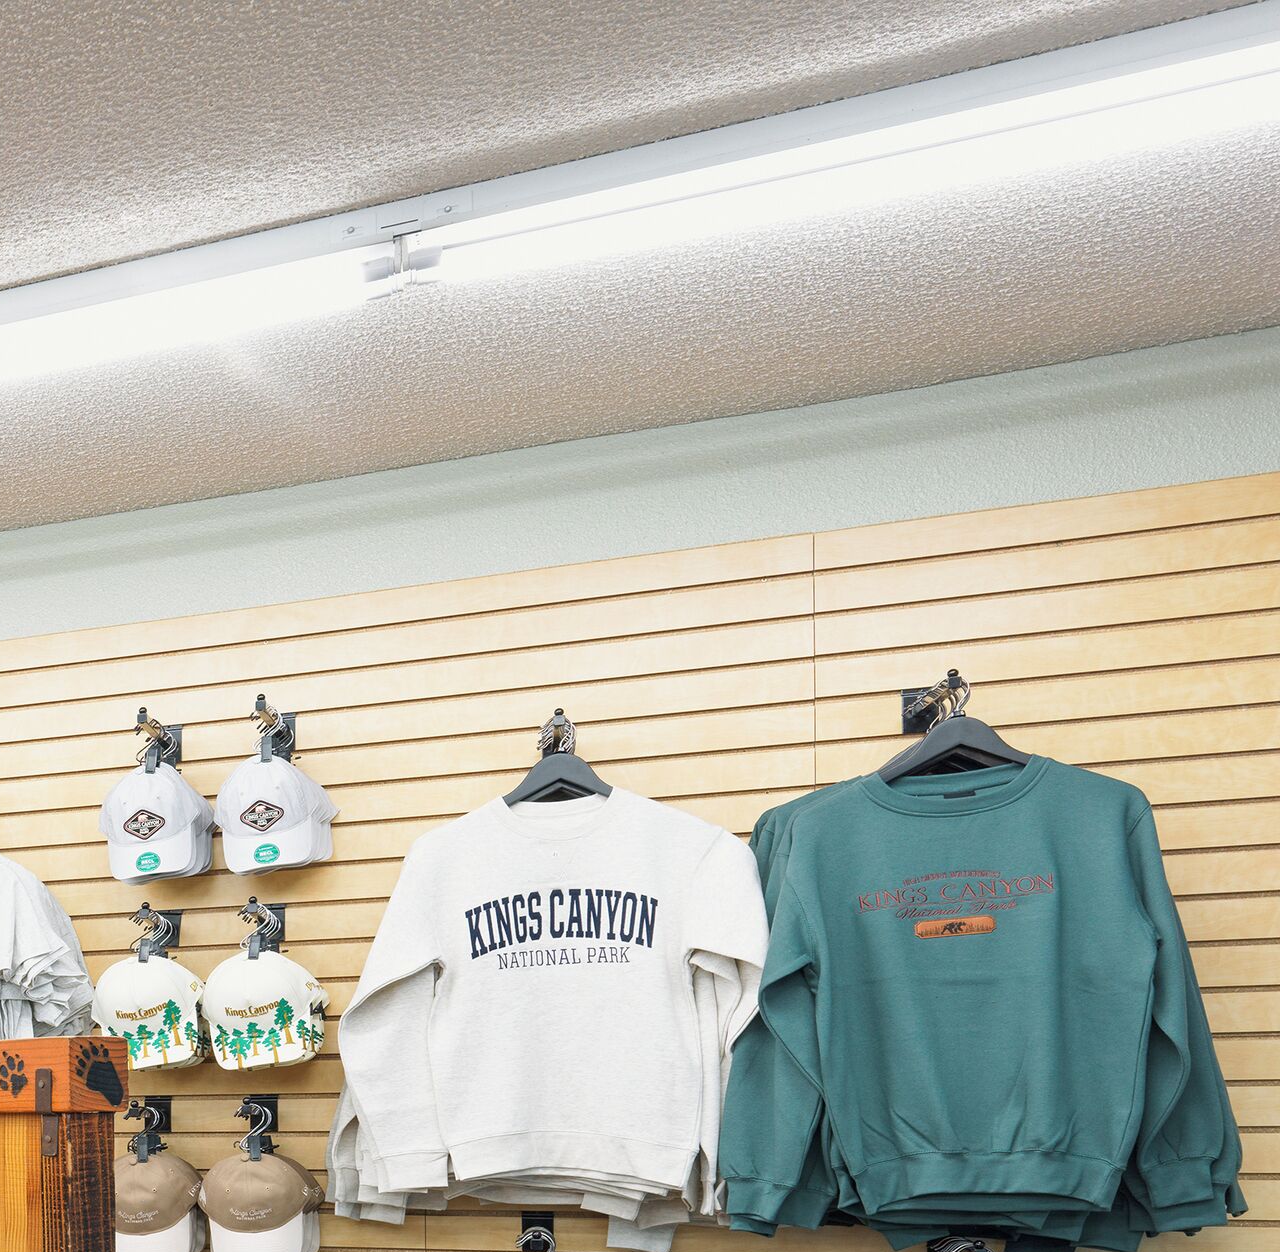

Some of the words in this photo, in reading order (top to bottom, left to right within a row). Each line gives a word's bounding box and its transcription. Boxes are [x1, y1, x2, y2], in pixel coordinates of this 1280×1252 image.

[859, 887, 928, 911] KINGS
[940, 873, 1054, 900] CANYON
[465, 891, 542, 959] KINGS
[549, 889, 658, 948] CANYON
[497, 950, 581, 970] NATIONAL
[587, 947, 630, 963] PARK
[116, 1009, 138, 1021] Kings
[138, 1002, 168, 1019] Canyon
[225, 1007, 244, 1018] Kings
[244, 1000, 279, 1017] Canyon
